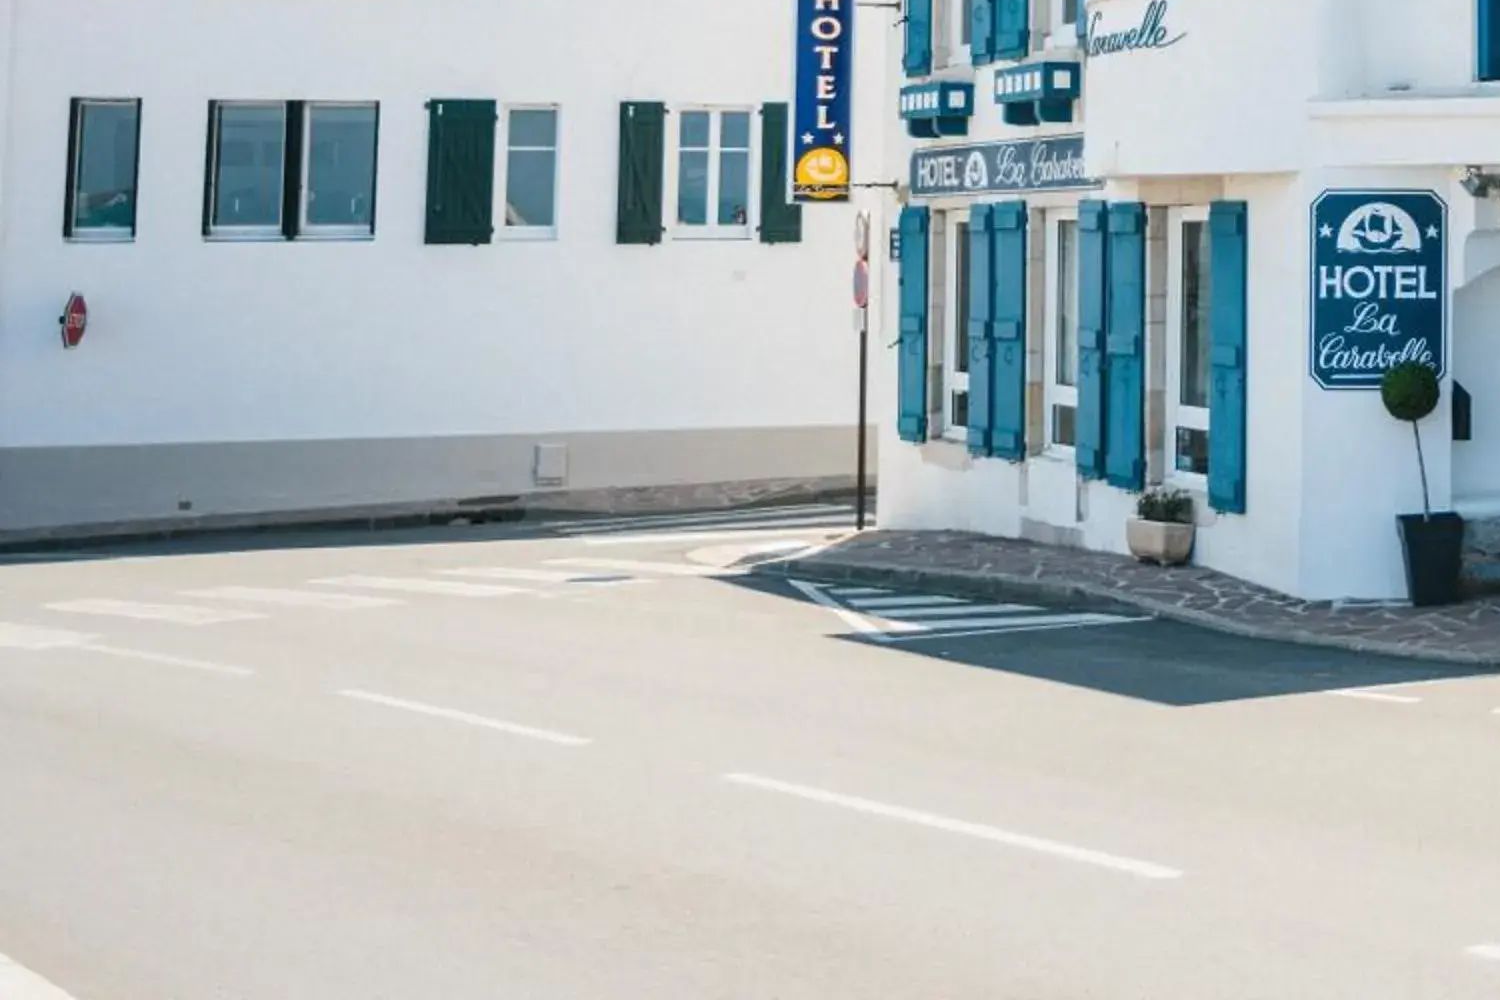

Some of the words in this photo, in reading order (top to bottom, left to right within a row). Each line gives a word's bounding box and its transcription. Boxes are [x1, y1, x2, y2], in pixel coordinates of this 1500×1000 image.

[917, 155, 960, 188] HOTEL
[995, 145, 1027, 187] La
[1318, 265, 1437, 300] HOTEL
[1344, 302, 1401, 336] La
